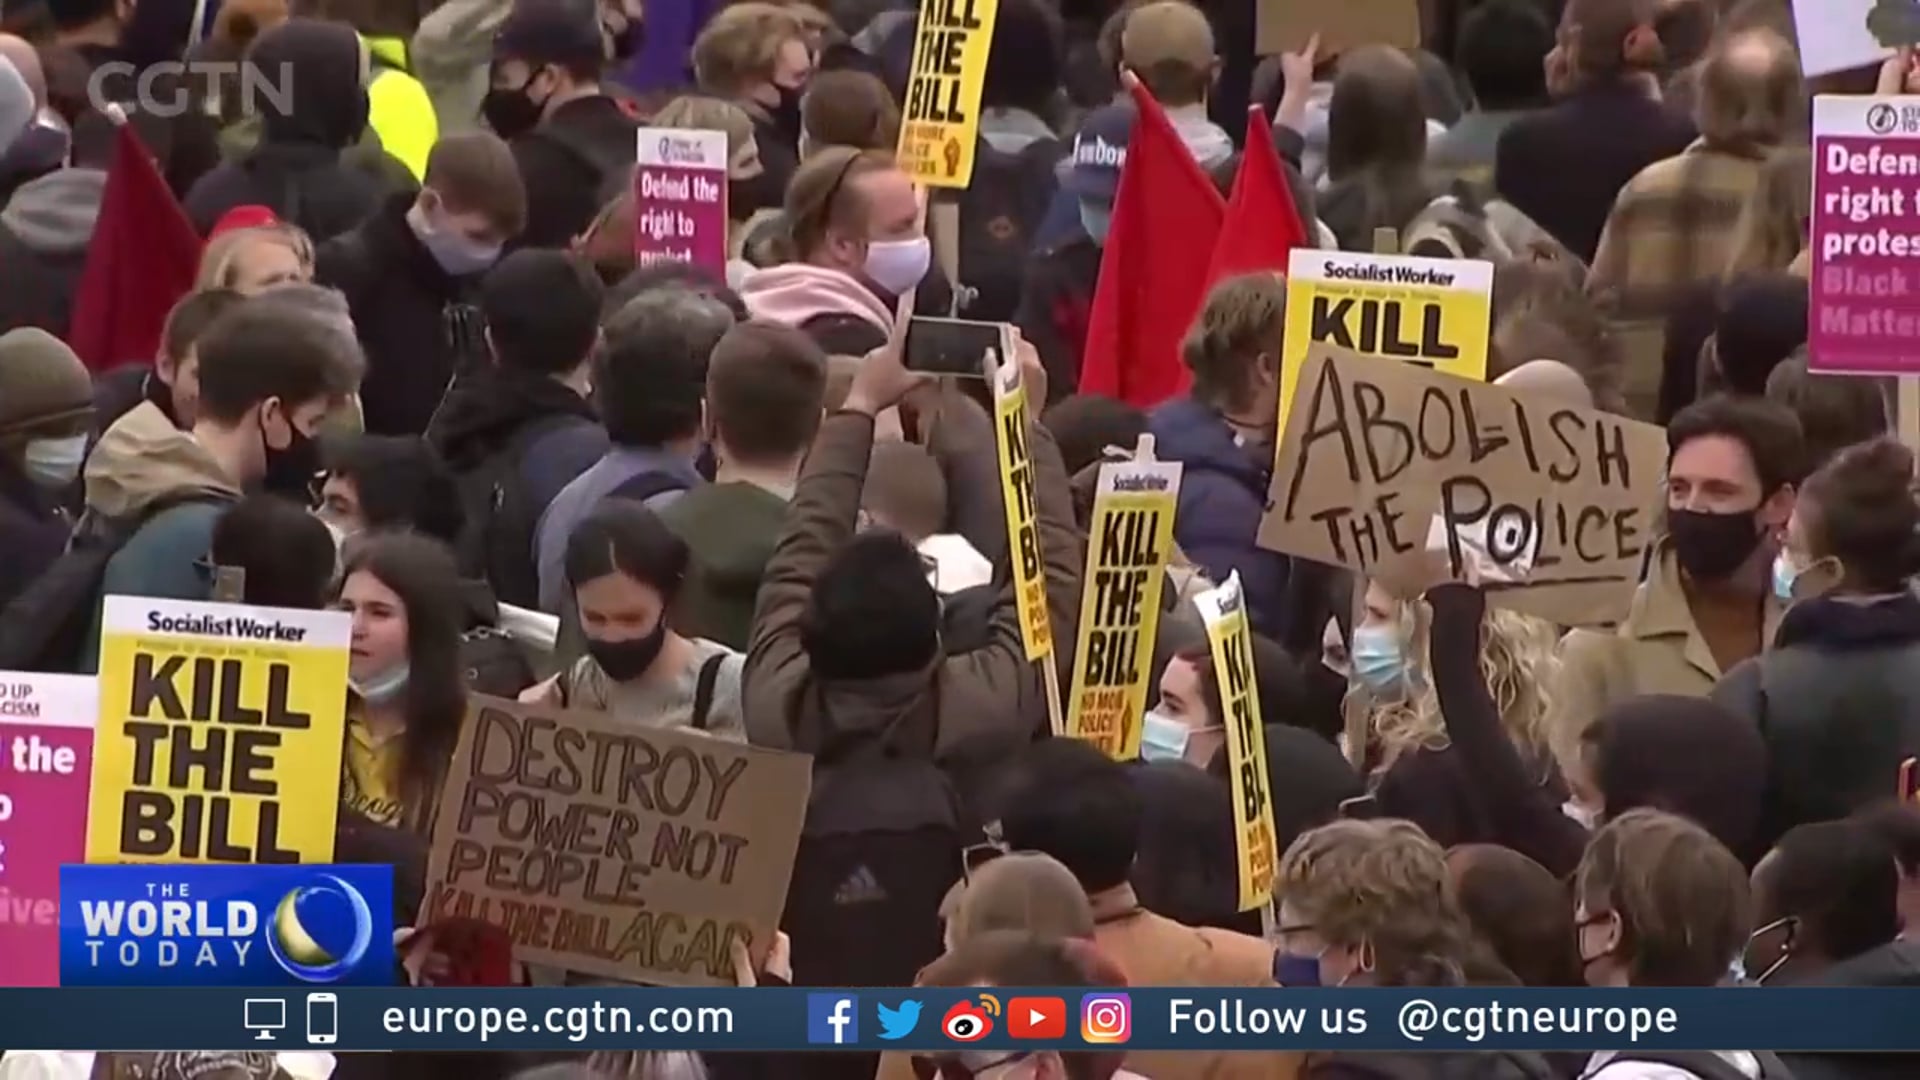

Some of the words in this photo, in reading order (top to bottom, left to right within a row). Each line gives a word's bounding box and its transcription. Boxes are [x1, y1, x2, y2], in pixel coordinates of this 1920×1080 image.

[917, 30, 967, 75] THE
[908, 77, 965, 124] BILL
[642, 171, 689, 200] Defend
[693, 176, 719, 202] the
[1824, 186, 1905, 222] right
[640, 207, 674, 240] right
[678, 211, 694, 236] to
[1324, 260, 1394, 283] Socialist
[1395, 266, 1456, 287] Worker
[1823, 265, 1910, 296] Black
[1311, 295, 1460, 359] KILL
[1820, 305, 1920, 337] Matte
[1284, 357, 1630, 523] ABOLISH
[1099, 510, 1160, 567] KILL
[1311, 491, 1414, 569] THE
[1440, 475, 1641, 580] POLICE
[147, 610, 232, 637] Socialist
[235, 617, 307, 642] Worker
[1095, 569, 1149, 627] THE
[1084, 629, 1140, 687] BILL
[11, 683, 33, 700] UP
[130, 652, 311, 730] KILL
[12, 734, 76, 774] the
[123, 721, 282, 797] THE
[470, 707, 749, 822] DESTROY
[119, 788, 302, 865] BILL
[457, 775, 640, 862] POWER
[650, 820, 750, 885] NOT
[446, 838, 652, 907] PEOPLE
